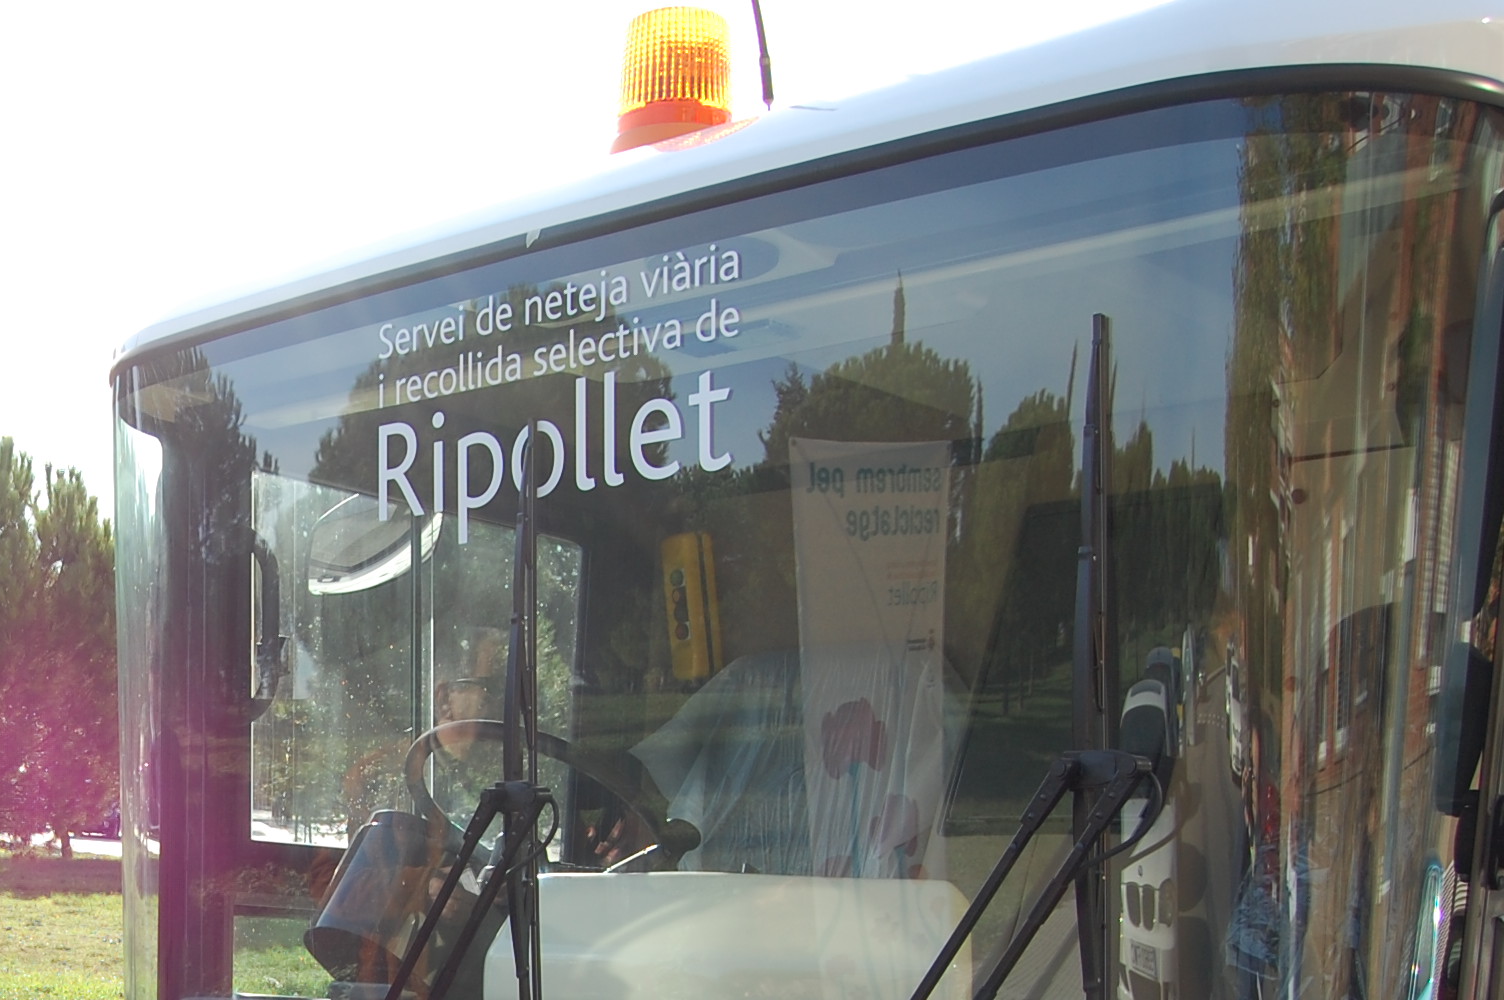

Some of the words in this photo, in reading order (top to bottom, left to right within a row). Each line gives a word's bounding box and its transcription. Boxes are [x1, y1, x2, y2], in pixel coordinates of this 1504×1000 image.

[378, 314, 464, 360] Servei
[475, 296, 513, 337] de
[524, 270, 628, 325] neteja
[640, 244, 740, 298] viària
[378, 373, 385, 408] i
[396, 347, 522, 403] recollida
[533, 317, 682, 376] selectiva
[695, 298, 740, 342] de
[378, 369, 733, 545] Ripollet
